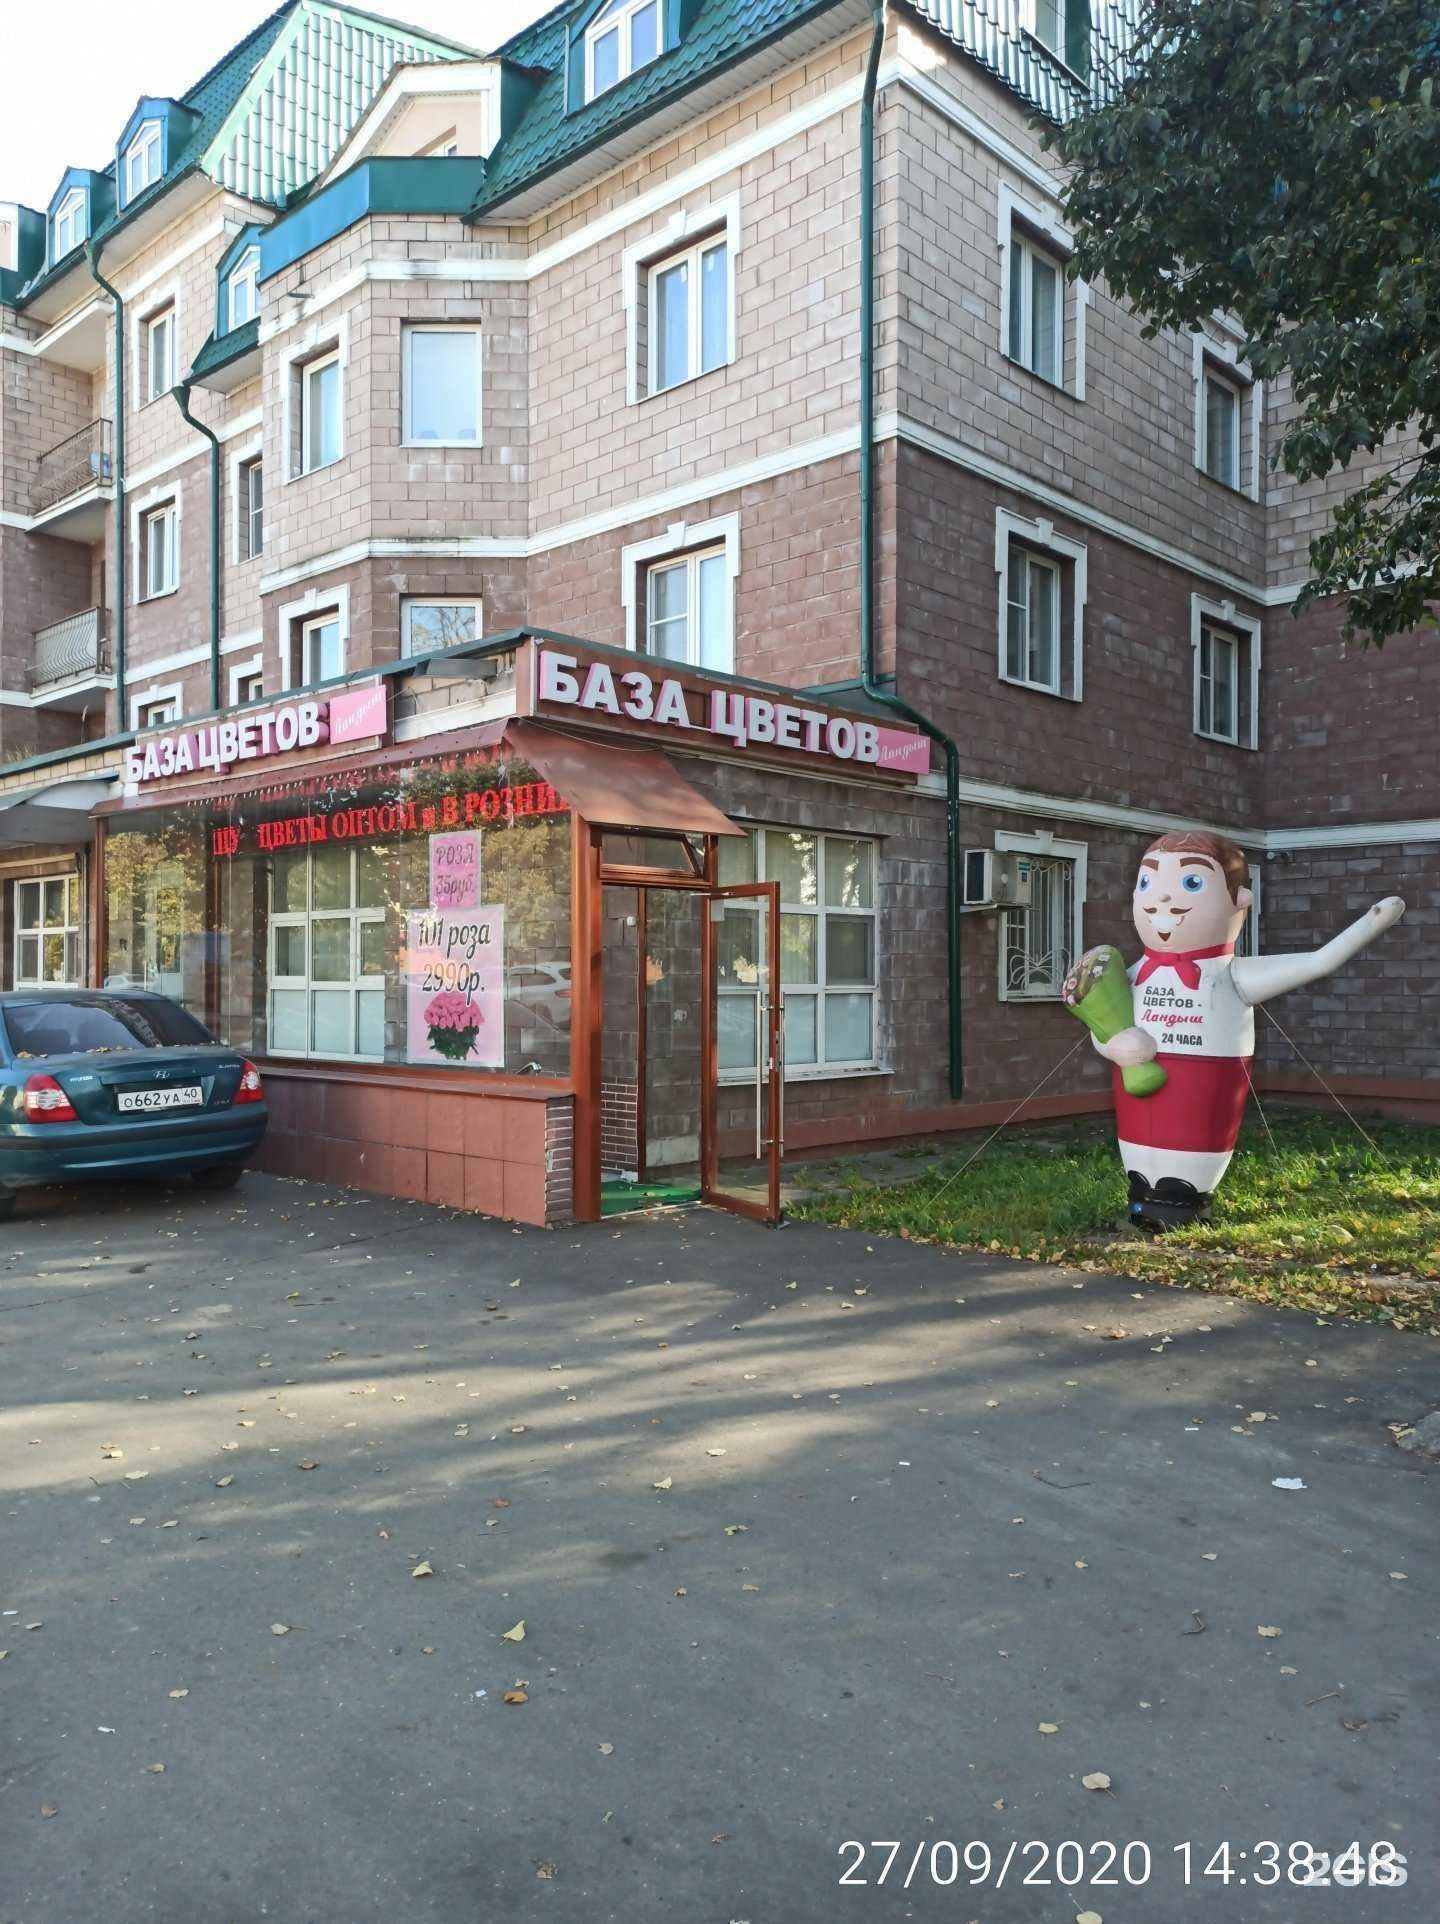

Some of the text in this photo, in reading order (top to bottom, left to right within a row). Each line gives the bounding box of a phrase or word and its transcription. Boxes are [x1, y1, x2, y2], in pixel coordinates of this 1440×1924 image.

[540, 650, 691, 728] БАЗА
[710, 689, 879, 763] ЦВЕТОВ
[124, 734, 195, 783] БАЗА
[198, 701, 322, 775] ЦВЕТОВ
[258, 814, 328, 850] ЦВЕТЫ
[331, 801, 417, 839] ОПТОМ
[441, 794, 460, 826] В
[419, 917, 491, 959] 101 роза
[422, 962, 485, 1005] 2990р.
[1143, 996, 1194, 1008] ЦВЕТОВ
[1145, 986, 1175, 997] БАЗА
[1141, 1009, 1204, 1027] Ландыш
[1161, 1033, 1203, 1046] 24 ЧАСА
